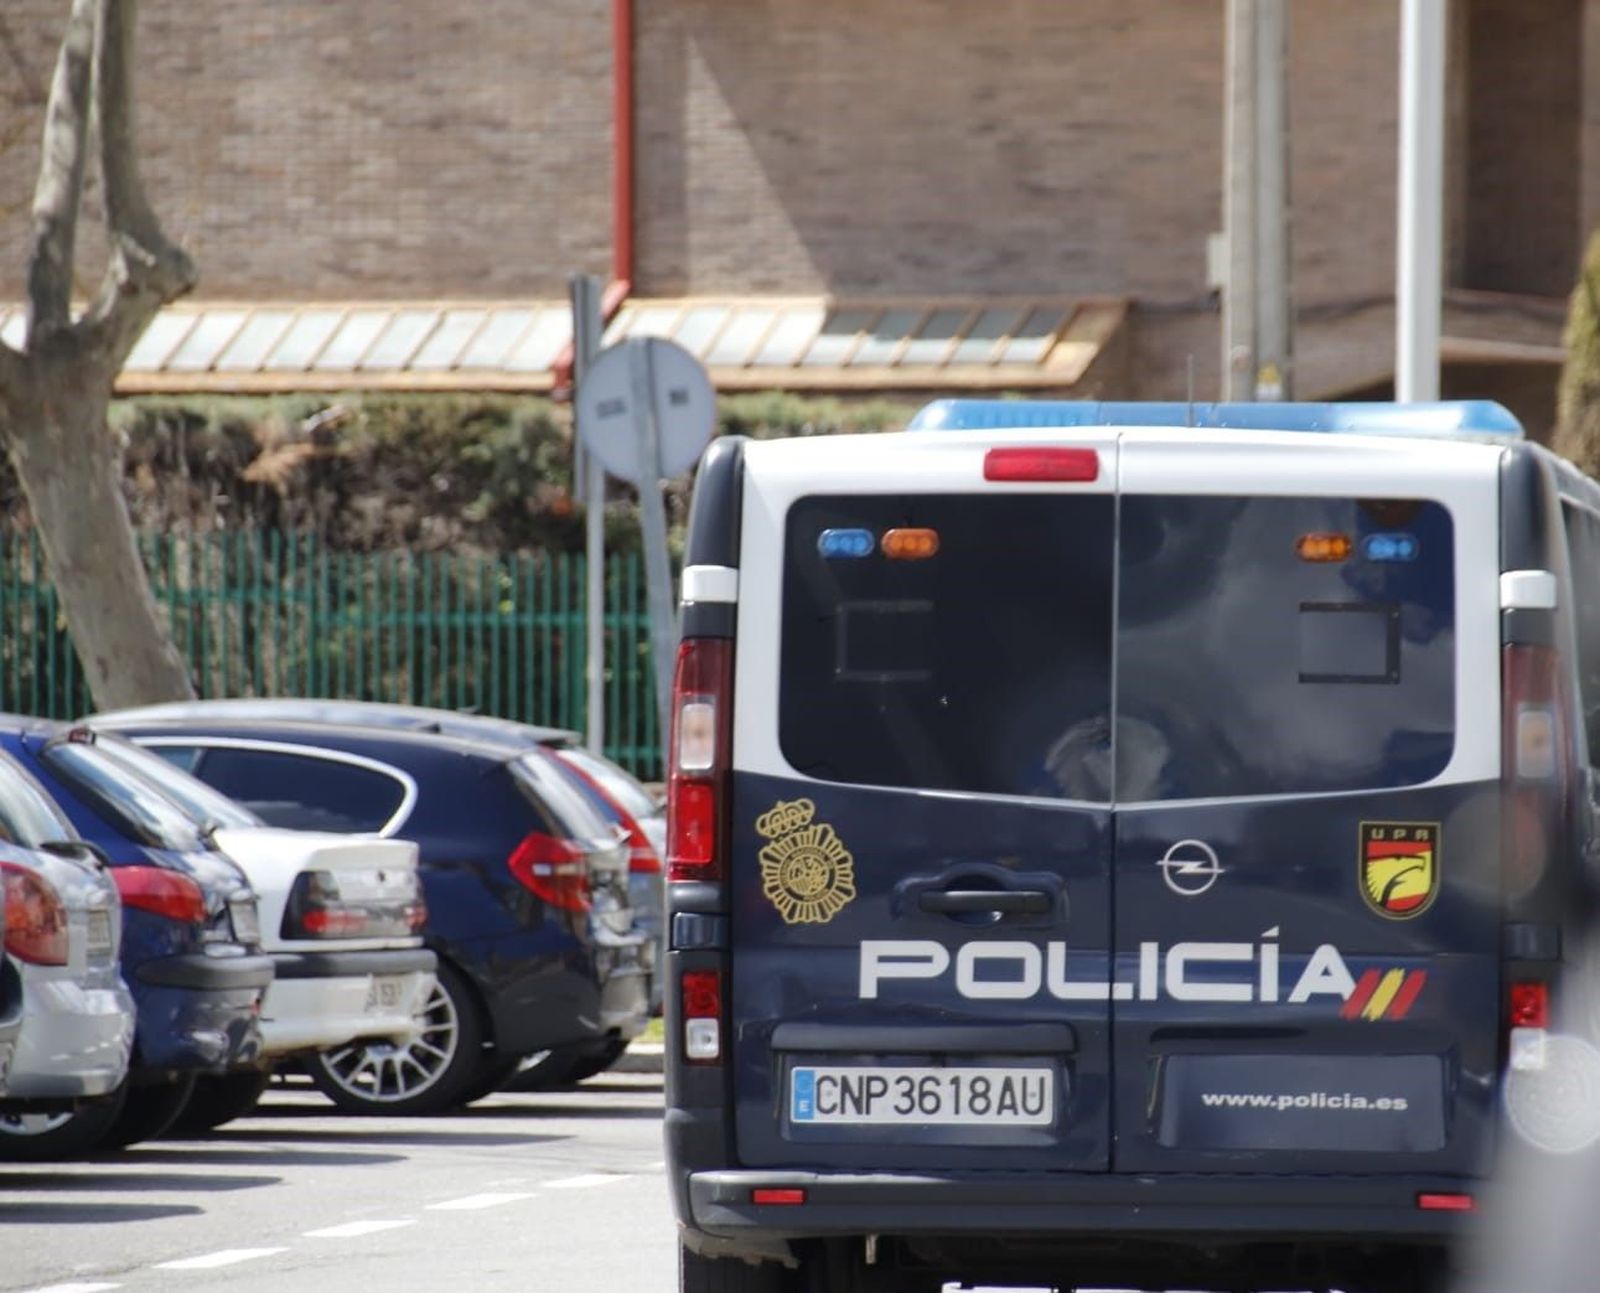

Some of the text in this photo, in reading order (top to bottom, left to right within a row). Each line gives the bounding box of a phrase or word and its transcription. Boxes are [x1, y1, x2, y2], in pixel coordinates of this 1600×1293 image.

[1371, 828, 1429, 841] UPR
[859, 925, 1358, 1002] POLICÍA
[815, 1075, 1045, 1116] CNP3618AU
[1201, 1093, 1408, 1110] www.policia.es
